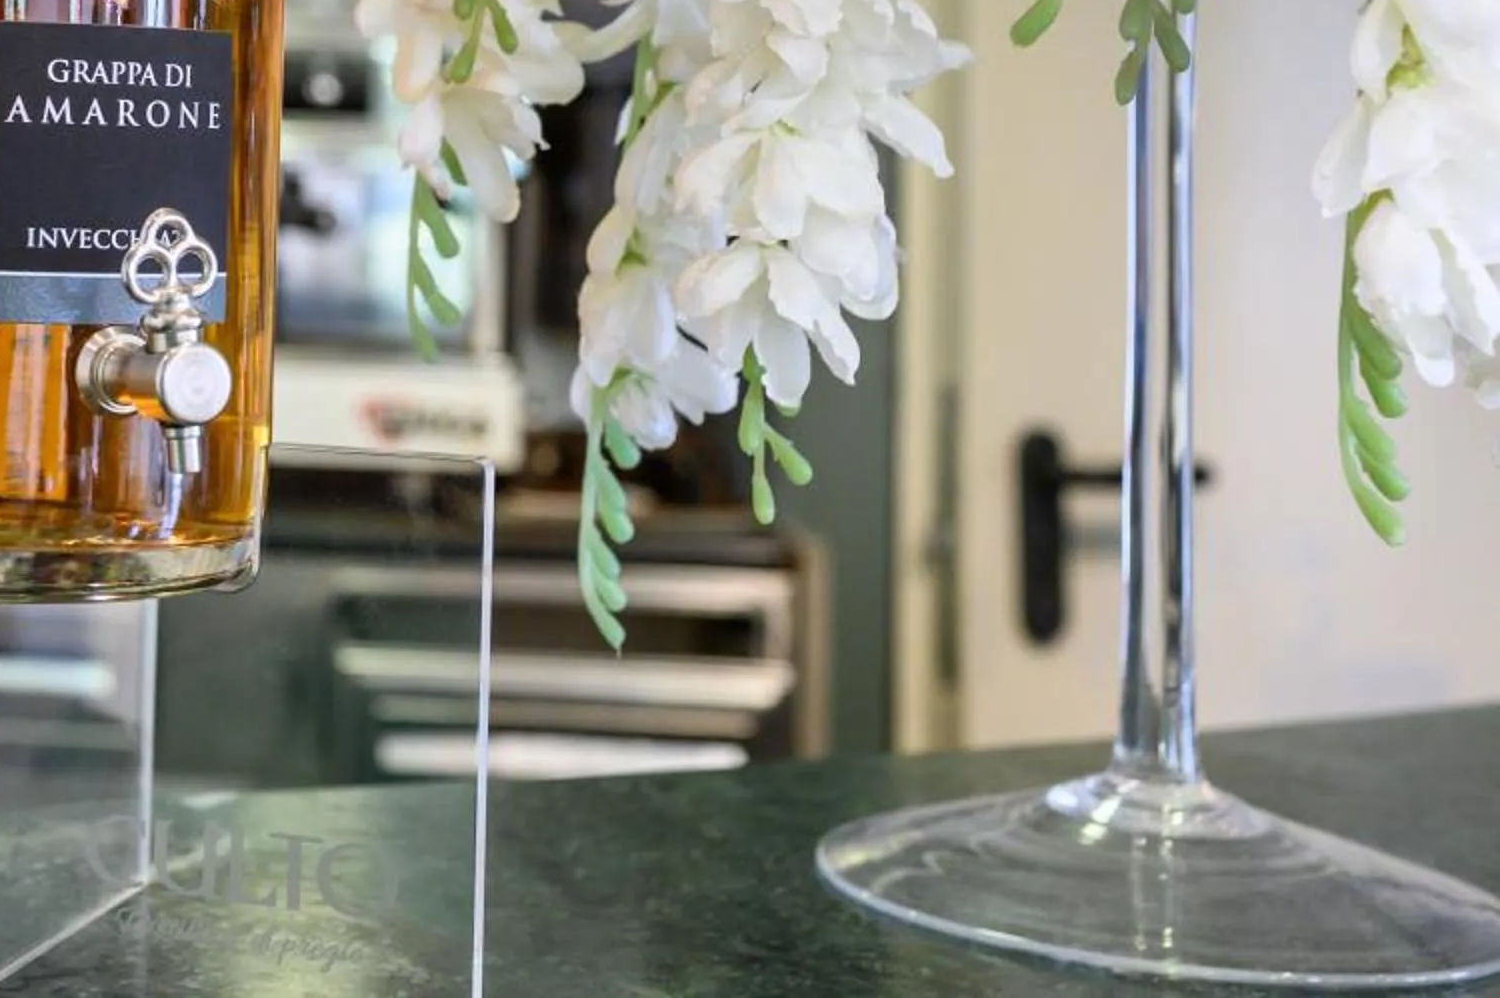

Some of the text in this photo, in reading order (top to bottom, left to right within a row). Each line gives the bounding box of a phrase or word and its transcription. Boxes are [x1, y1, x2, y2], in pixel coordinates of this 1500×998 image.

[47, 58, 192, 89] GRAPPA DI
[4, 94, 221, 129] AMARONE
